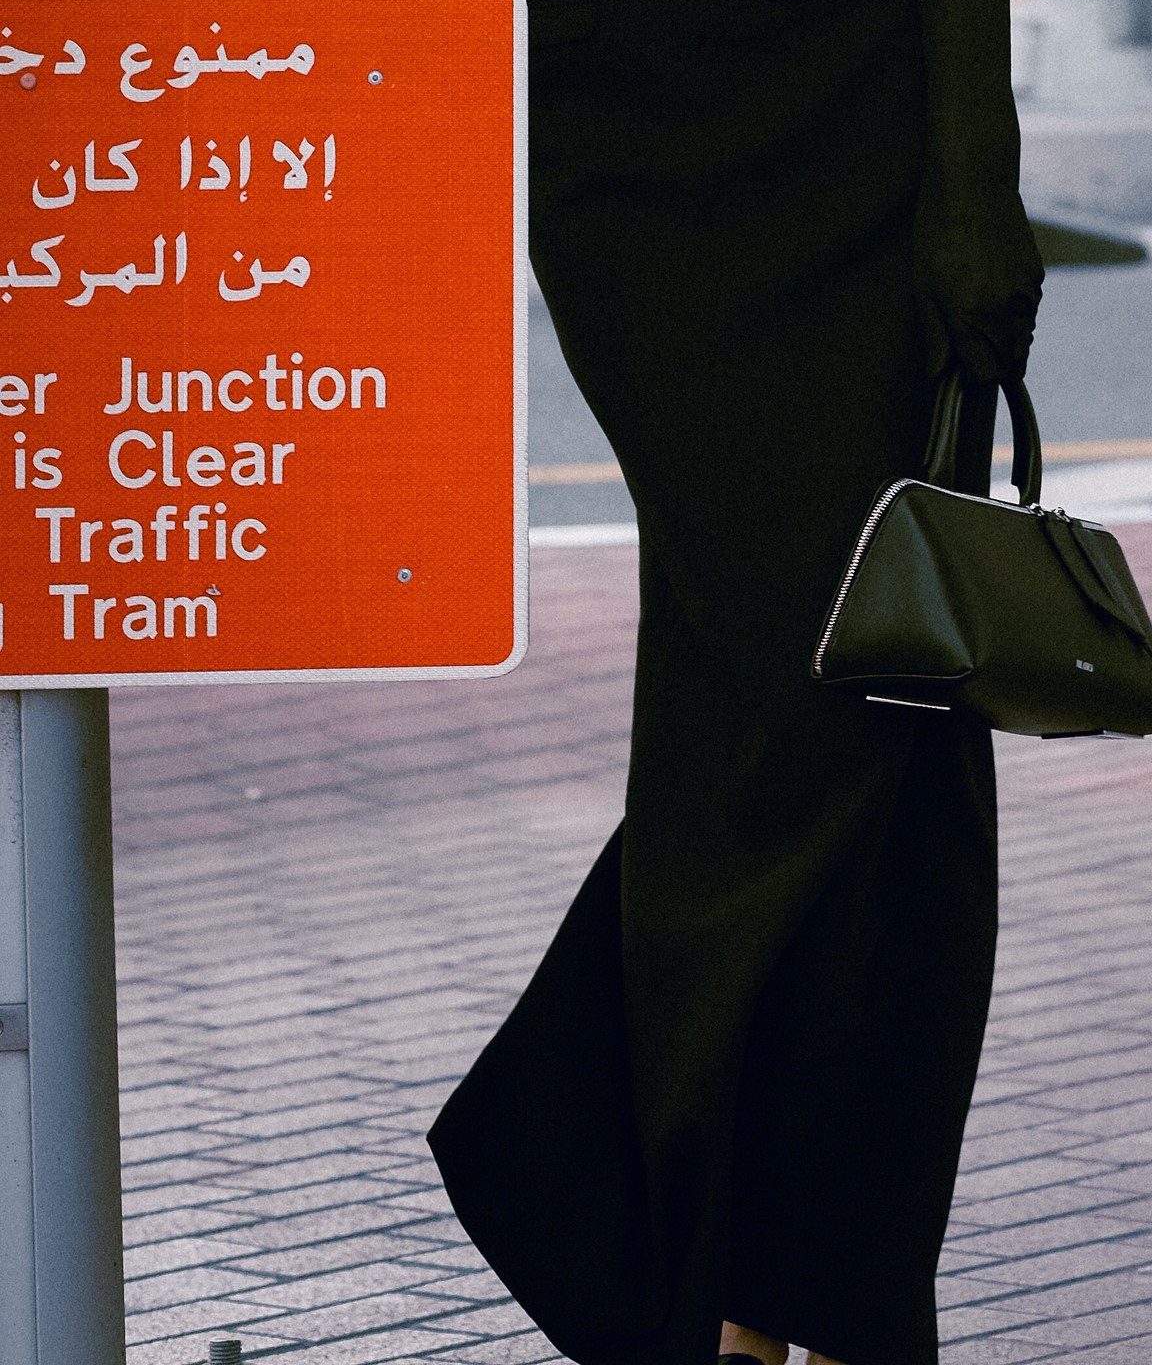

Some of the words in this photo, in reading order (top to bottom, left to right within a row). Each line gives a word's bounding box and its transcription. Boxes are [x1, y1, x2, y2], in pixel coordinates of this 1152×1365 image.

[119, 22, 315, 103] ممنوع
[32, 138, 143, 210] كان
[179, 135, 252, 203] إذا
[272, 134, 336, 202] إلا
[218, 250, 311, 302] من
[103, 351, 387, 415] Junction
[13, 431, 63, 490] is
[108, 429, 296, 489] Clear
[35, 502, 267, 563] Traffic
[48, 583, 221, 640] Tram
